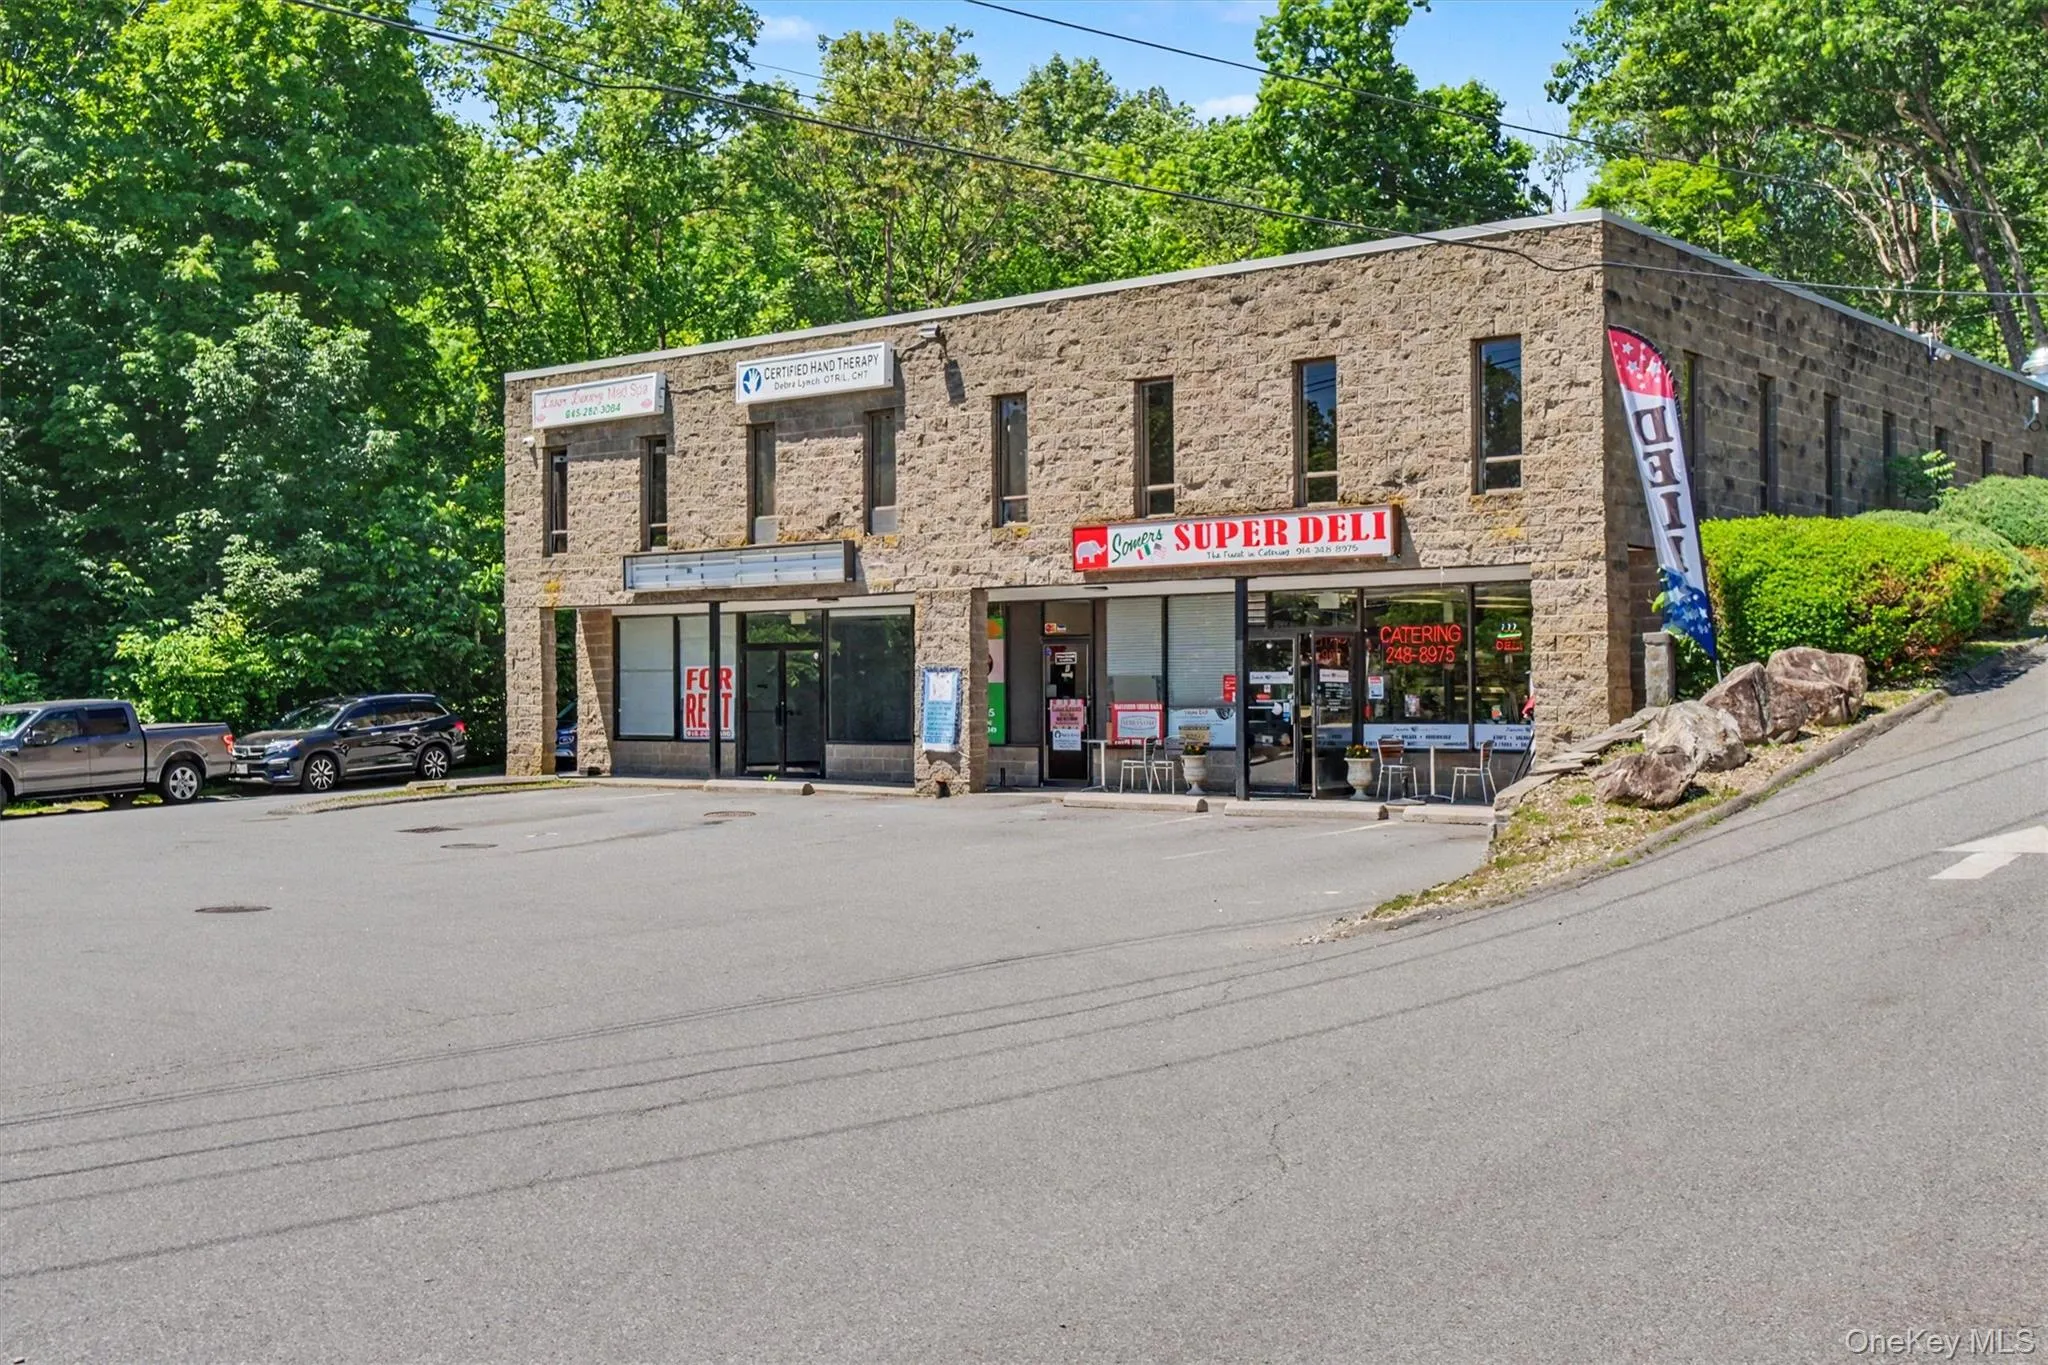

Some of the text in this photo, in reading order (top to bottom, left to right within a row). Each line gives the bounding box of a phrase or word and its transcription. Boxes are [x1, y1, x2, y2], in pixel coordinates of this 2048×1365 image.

[764, 353, 880, 380] CERTIFIED HAND THERAPY
[630, 383, 649, 398] Spa
[774, 378, 796, 390] Debra
[797, 377, 820, 389] Lynch
[1111, 511, 1387, 563] Somers SUPER DELI
[1380, 624, 1462, 643] CATERING
[1385, 645, 1456, 663] 248-8975
[686, 693, 733, 728] RET
